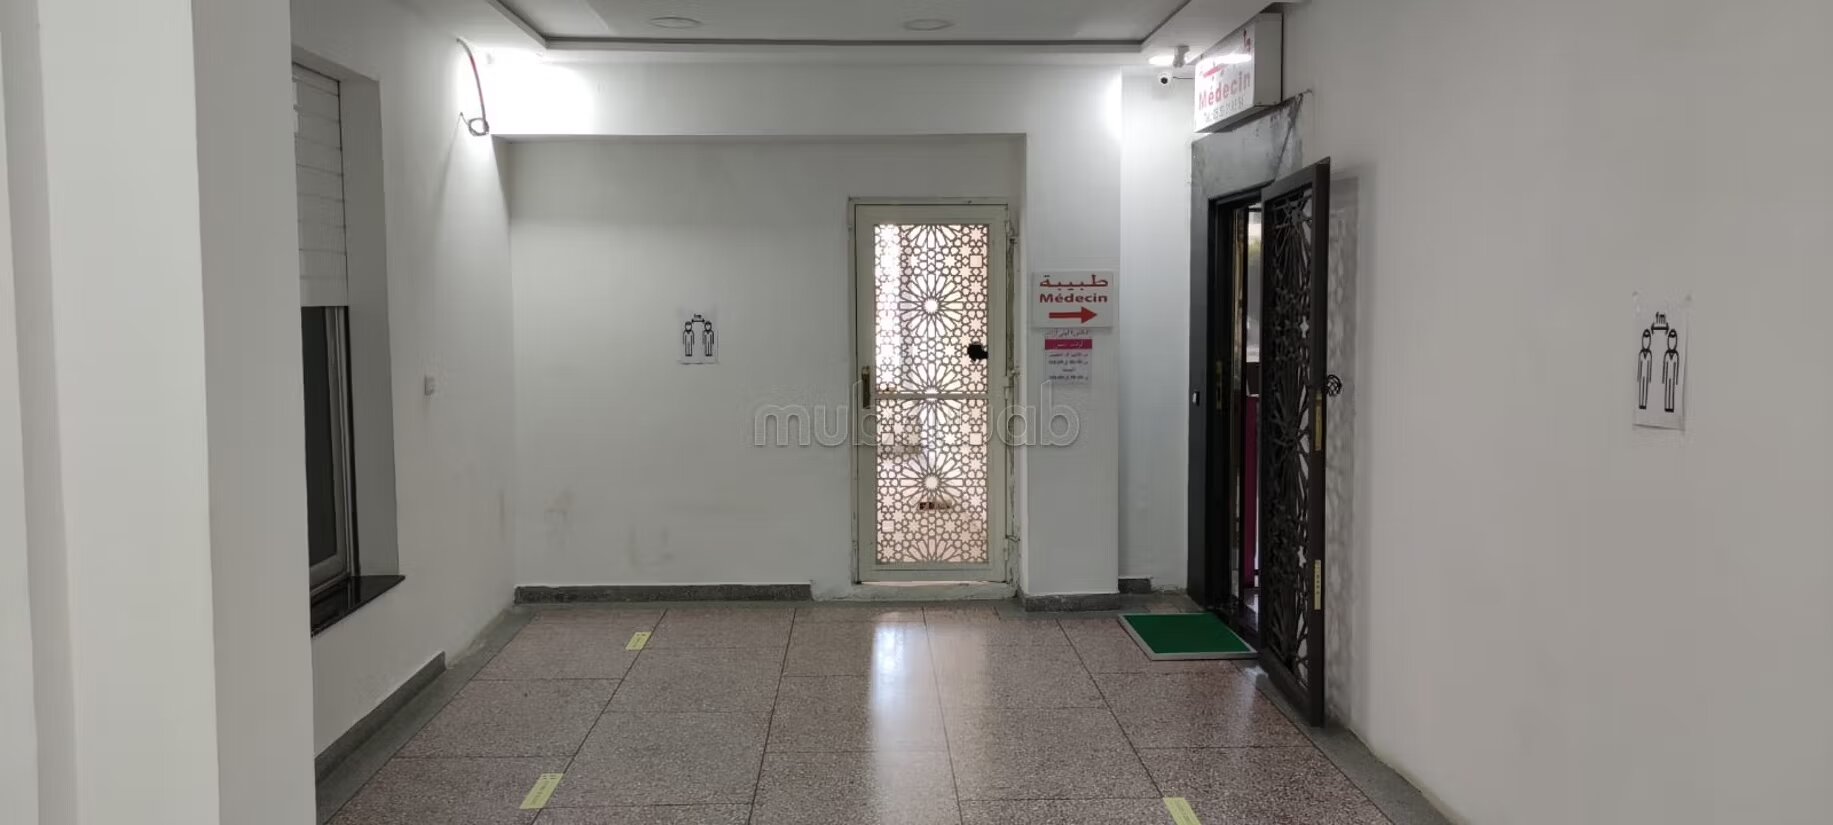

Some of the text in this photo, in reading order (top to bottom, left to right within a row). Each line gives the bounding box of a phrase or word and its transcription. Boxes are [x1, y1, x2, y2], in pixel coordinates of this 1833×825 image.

[1199, 71, 1251, 110] Médecin
[1039, 273, 1109, 291] طبيبة
[1039, 293, 1108, 303] Médecin
